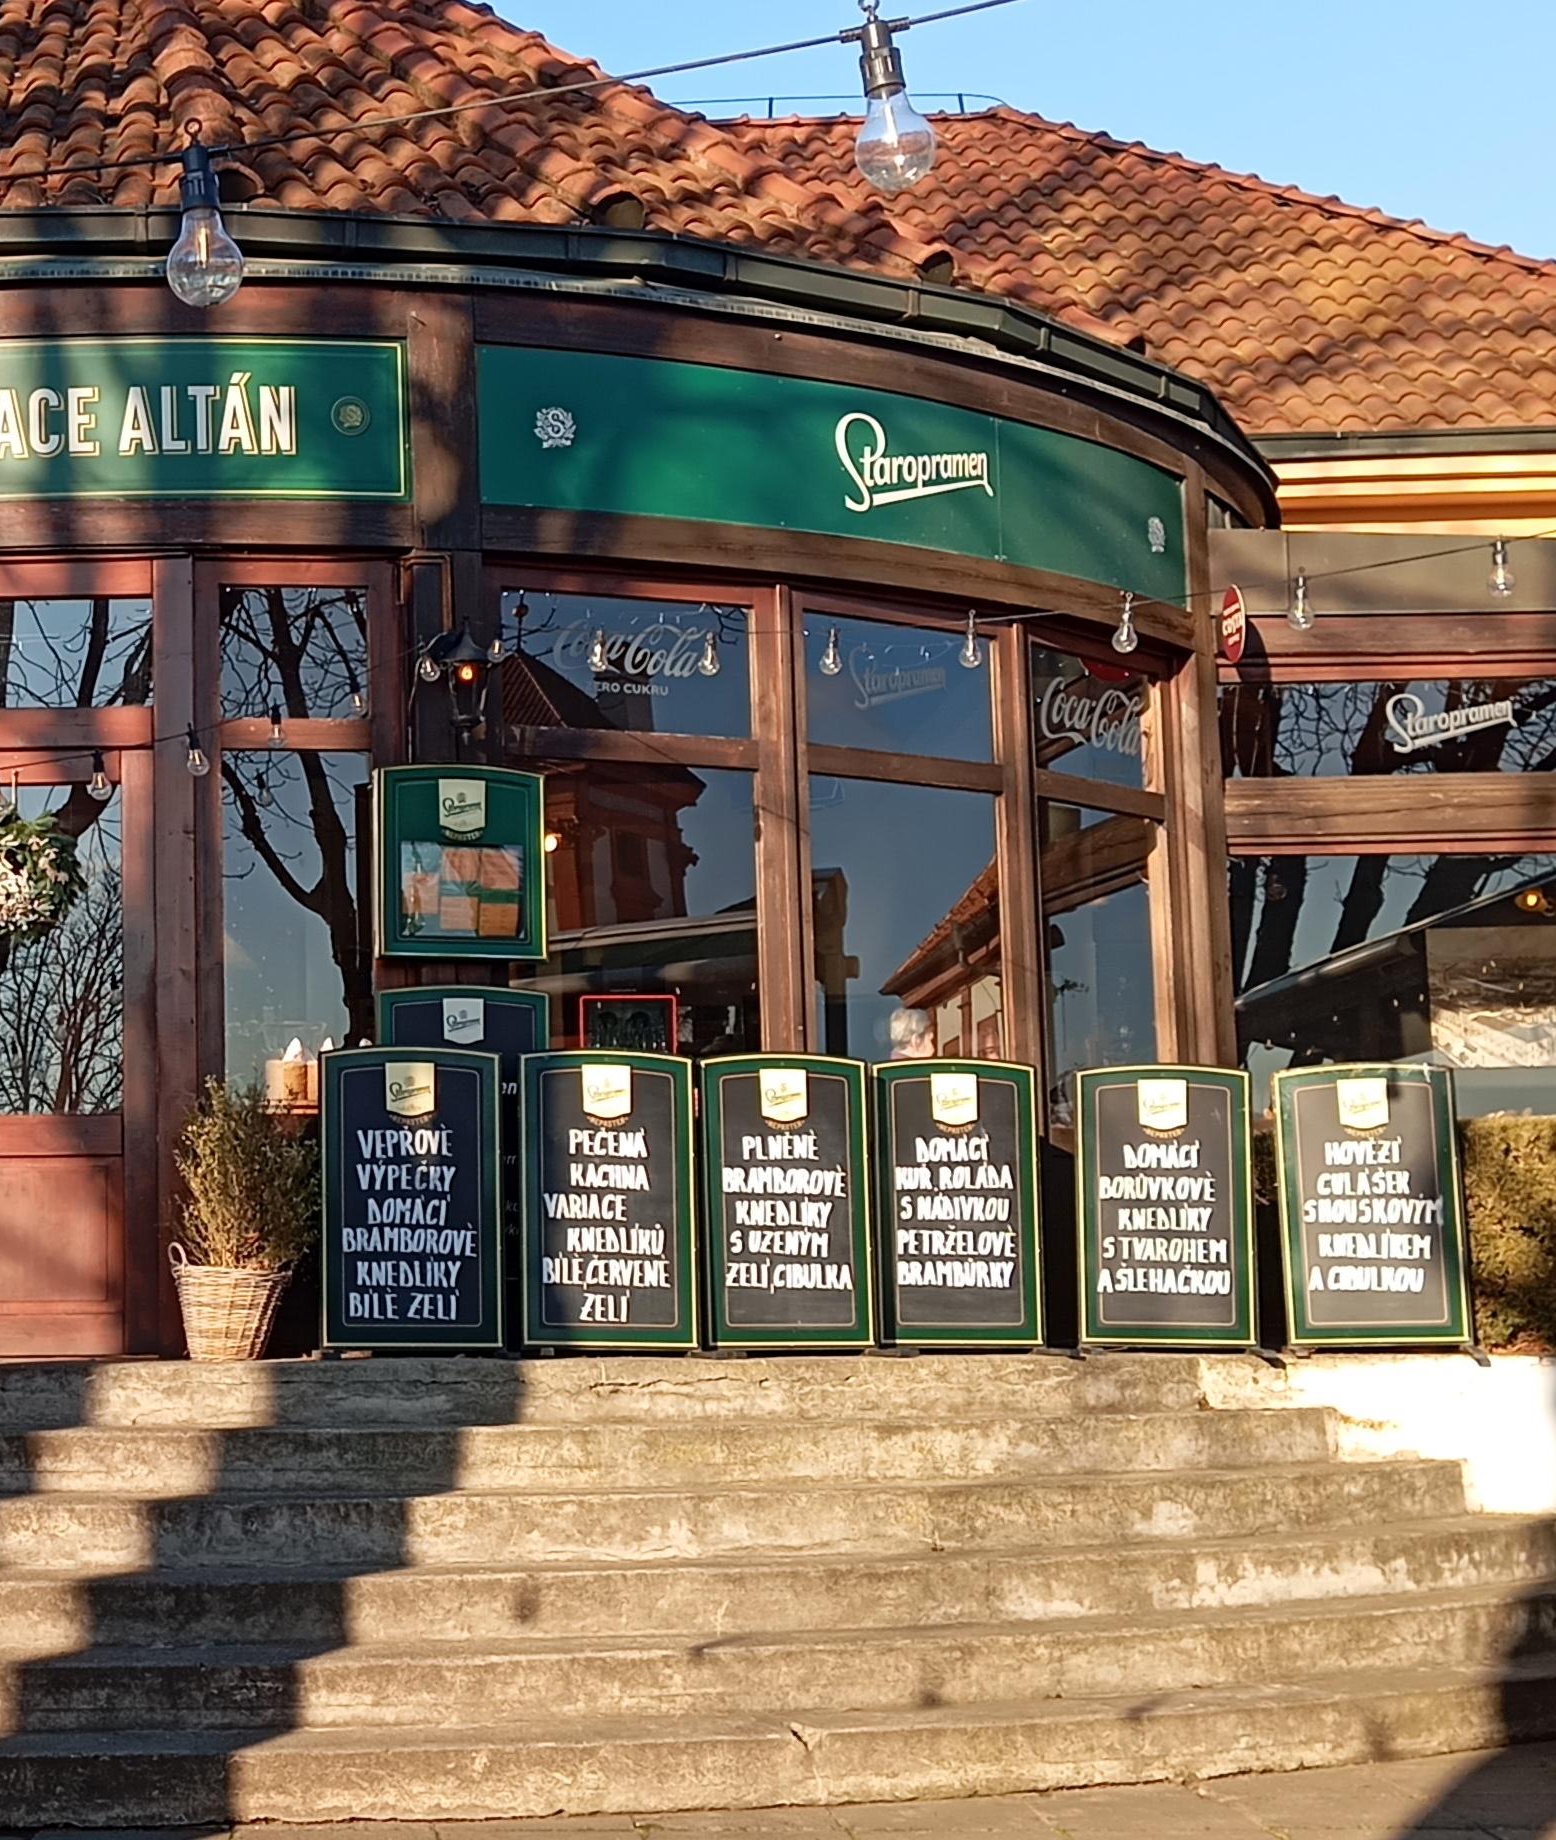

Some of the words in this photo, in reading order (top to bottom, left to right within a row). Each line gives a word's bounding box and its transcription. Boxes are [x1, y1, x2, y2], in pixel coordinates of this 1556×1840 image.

[117, 371, 297, 456] ALTÁN
[835, 412, 994, 512] Staropramen
[623, 681, 668, 696] CUKRU
[849, 645, 946, 710] Staropramen
[1041, 676, 1143, 756] Coca-Cola
[1386, 693, 1518, 753] Staropramen
[570, 1162, 650, 1191] KACHNA
[543, 1193, 628, 1221] VARIACE
[900, 1196, 913, 1220] S
[729, 1230, 743, 1254] S
[1102, 1236, 1116, 1258] S
[1118, 1237, 1227, 1263] TVAROHEM
[1097, 1268, 1113, 1293] A
[1308, 1265, 1324, 1291] A
[1327, 1265, 1424, 1292] CIBULKOU
